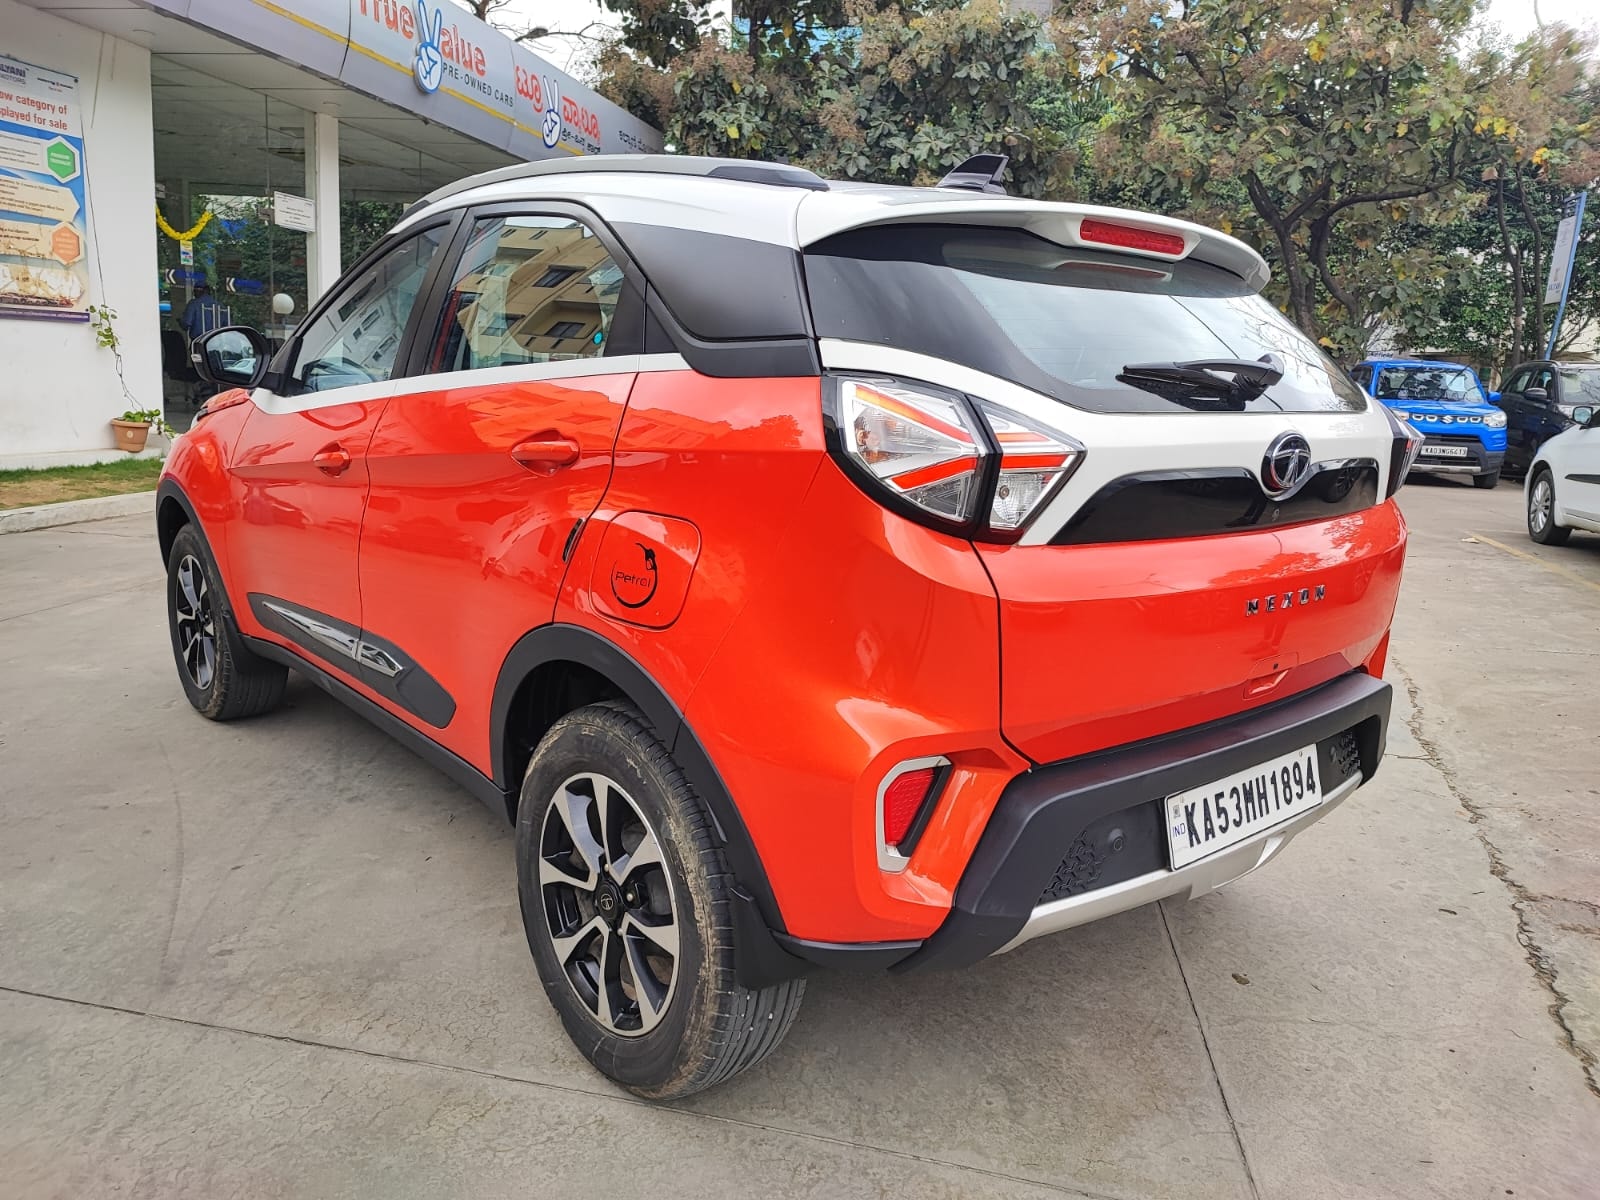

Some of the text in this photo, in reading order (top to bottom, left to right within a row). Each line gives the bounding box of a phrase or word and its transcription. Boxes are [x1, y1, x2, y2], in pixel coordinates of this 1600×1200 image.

[442, 62, 514, 108] PRE-OWNED CARS
[15, 95, 56, 115] category
[58, 104, 68, 116] of
[0, 106, 68, 131] played for sale
[615, 571, 651, 588] Petrol
[1245, 584, 1326, 617] NEXON
[1184, 755, 1316, 848] KA53MH1894
[1172, 822, 1186, 838] IND
